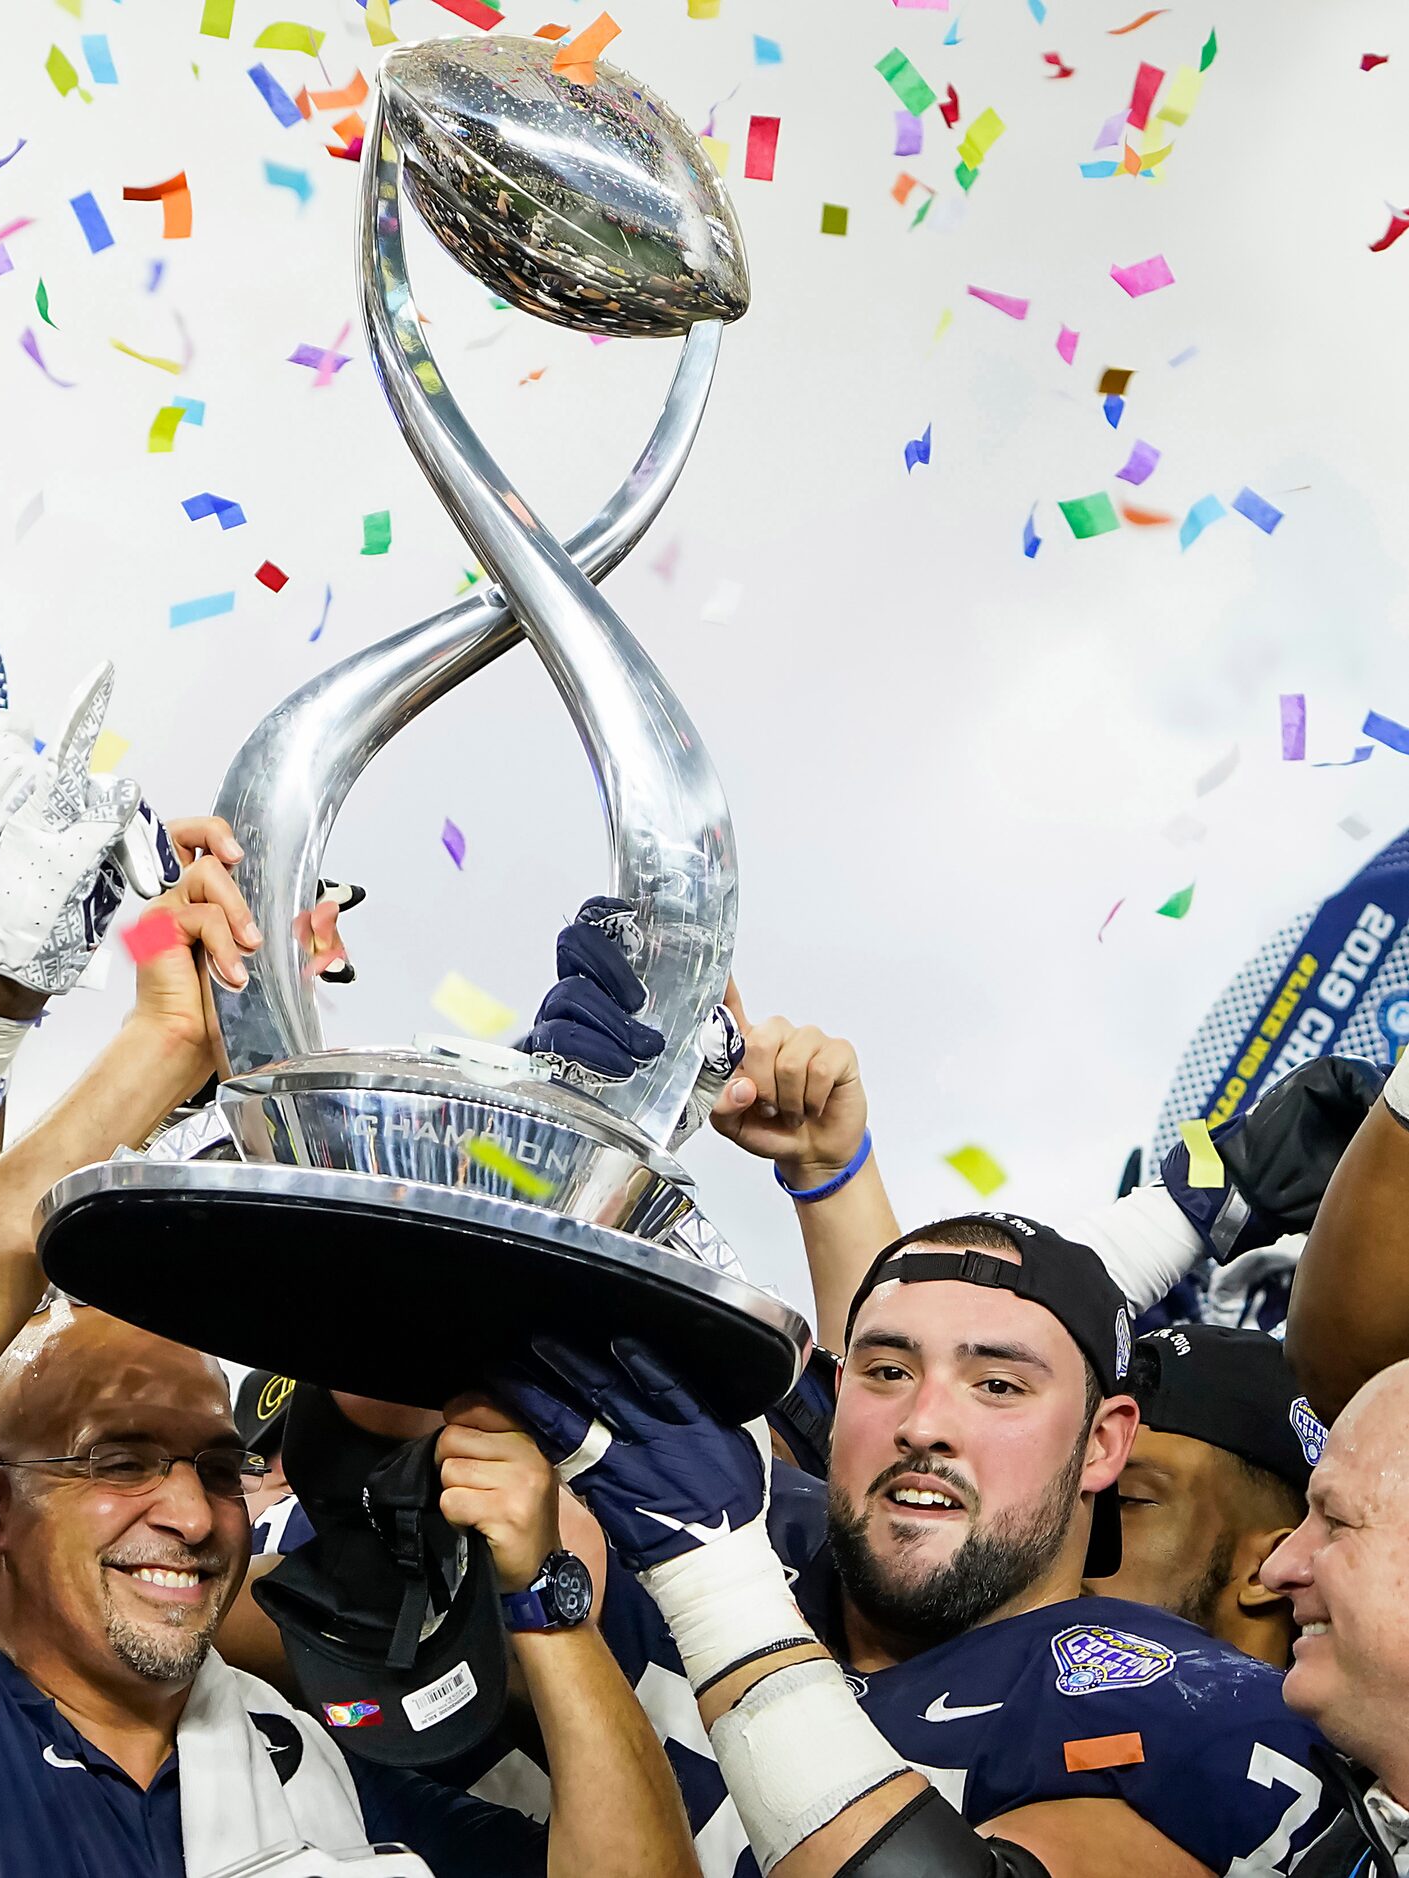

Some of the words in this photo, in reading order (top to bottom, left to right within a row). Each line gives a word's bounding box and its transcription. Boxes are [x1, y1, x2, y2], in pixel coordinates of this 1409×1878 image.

[1317, 902, 1395, 1011] 2019
[1169, 1332, 1192, 1357] 2019
[1296, 1409, 1330, 1441] COTTO
[1066, 1632, 1162, 1678] COTTON
[1072, 1649, 1130, 1678] BOWL
